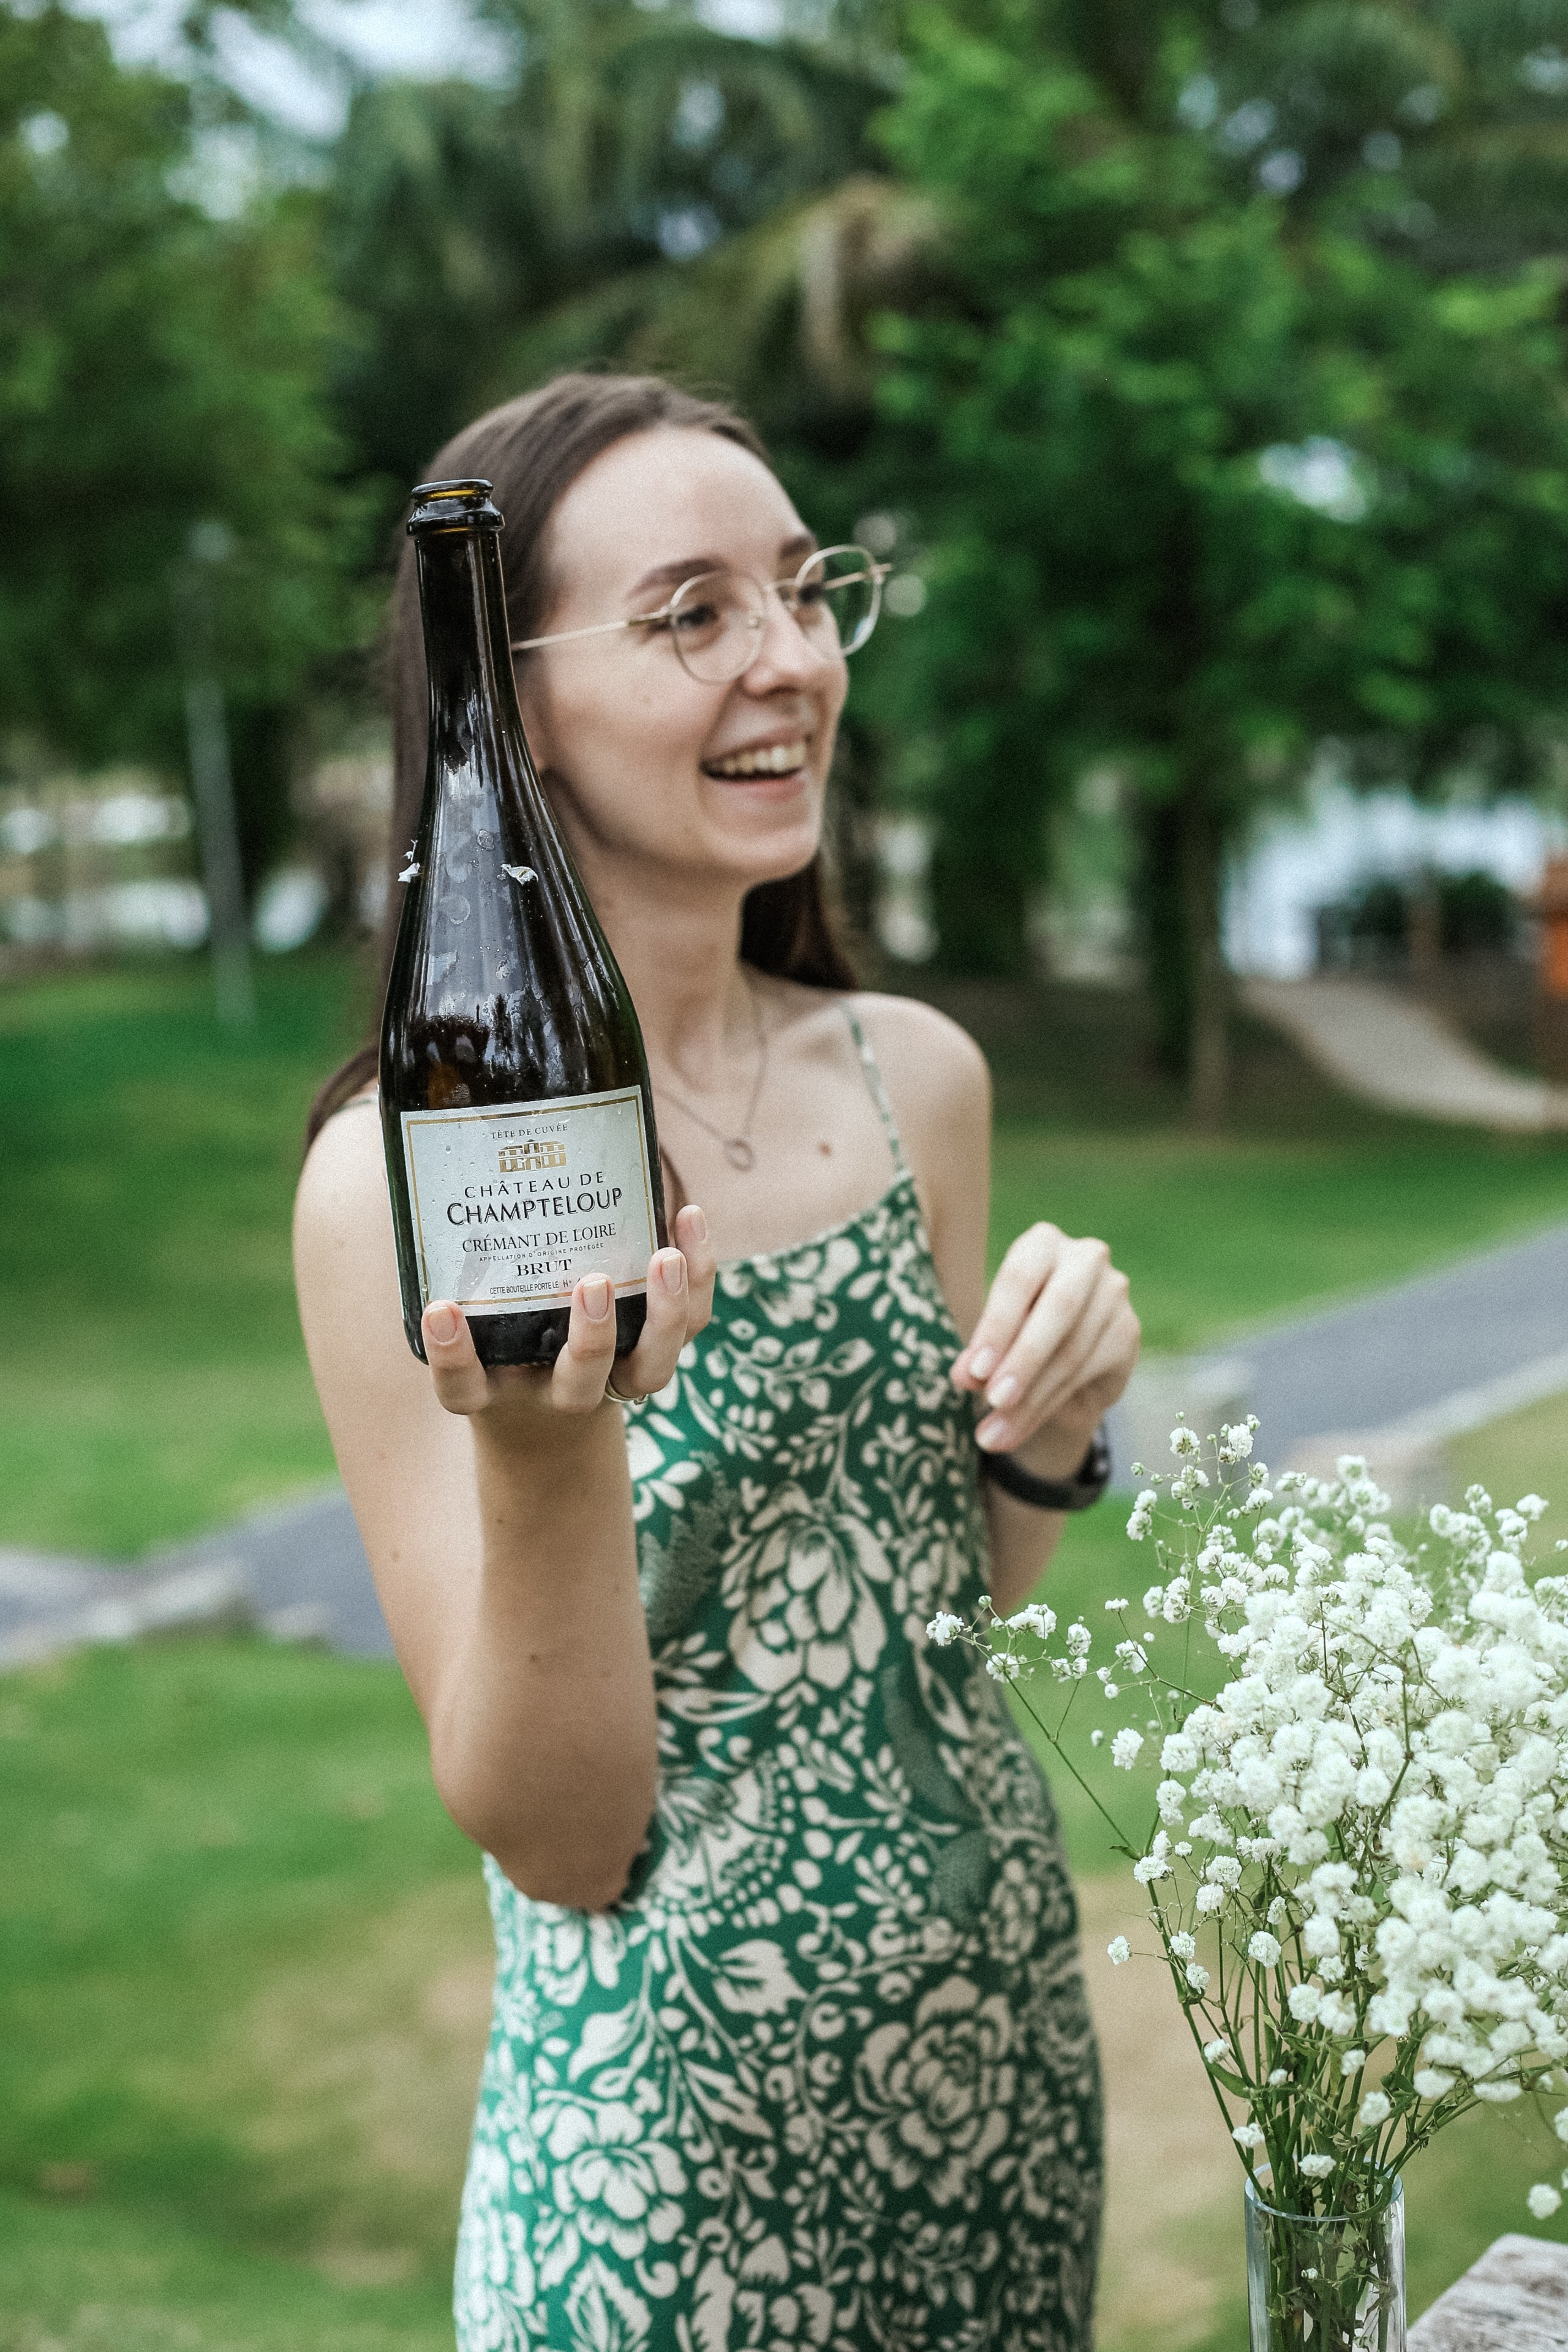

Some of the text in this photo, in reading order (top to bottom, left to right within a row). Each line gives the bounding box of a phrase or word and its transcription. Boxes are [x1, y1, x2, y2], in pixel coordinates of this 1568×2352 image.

[491, 1129, 516, 1139] TÊTE
[535, 1123, 568, 1134] CUVÉE
[464, 1171, 604, 1198] CHÂTEAU DE
[447, 1187, 622, 1226] CHAMPTELOUP
[462, 1223, 616, 1253] CRÉMANT DE LOIRE
[479, 1242, 604, 1262] APPELLATION D'ORIGINE PROTÉGÉE
[517, 1258, 572, 1276] BRUT
[507, 1284, 533, 1294] BOUTEILLE
[535, 1281, 551, 1291] PORTE
